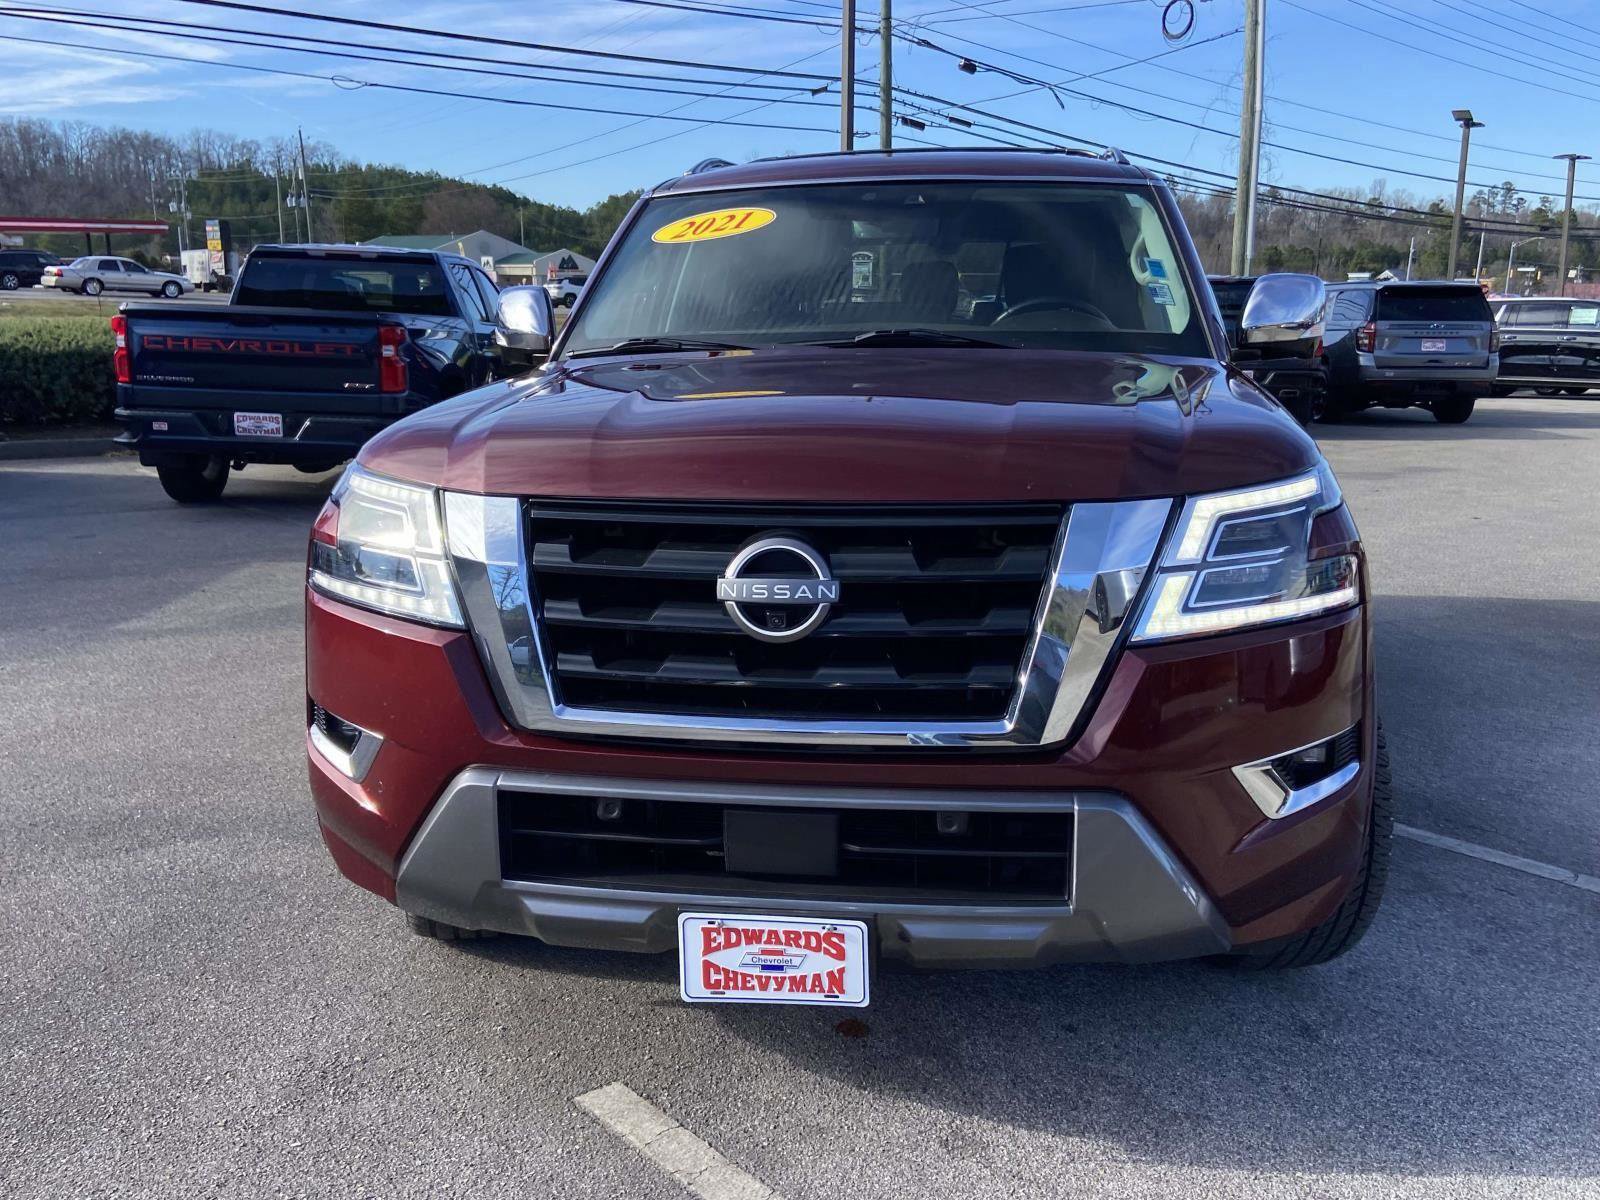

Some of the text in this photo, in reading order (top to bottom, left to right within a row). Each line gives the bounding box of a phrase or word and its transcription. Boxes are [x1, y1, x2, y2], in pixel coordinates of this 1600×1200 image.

[670, 211, 754, 240] 2021
[143, 335, 359, 355] CHEVROLET
[236, 415, 280, 424] EDWARDS
[236, 425, 280, 435] CHEVYMAN
[721, 583, 836, 599] NISSAN
[701, 926, 846, 962] EDWARDS
[751, 956, 793, 965] Chevrolet
[702, 959, 846, 995] CHEVYMAN
